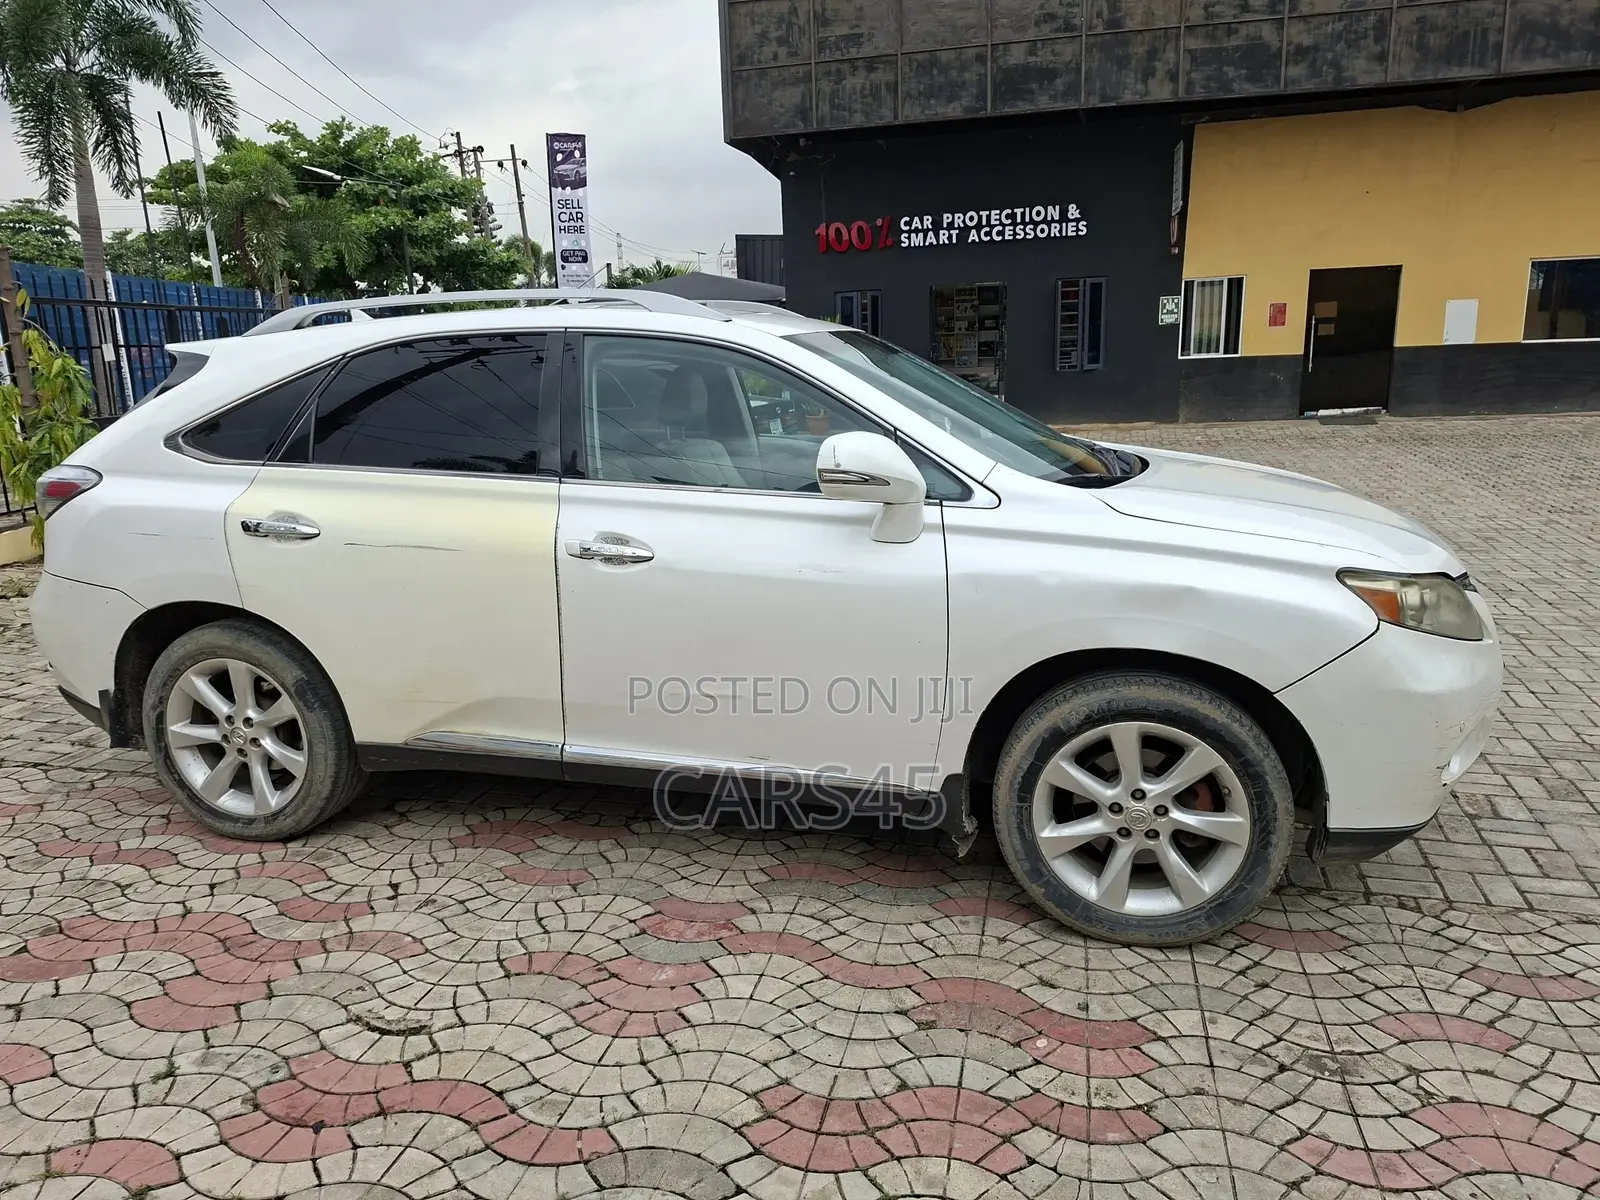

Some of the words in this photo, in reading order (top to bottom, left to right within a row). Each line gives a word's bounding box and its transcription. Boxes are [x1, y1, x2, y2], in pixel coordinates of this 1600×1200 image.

[557, 198, 583, 210] SELL
[557, 211, 584, 223] CAR
[900, 215, 933, 231] CAR
[942, 205, 1060, 229] PROTECTION
[1067, 203, 1082, 220] &
[558, 225, 585, 234] HERE
[815, 215, 894, 254] 100%
[900, 229, 959, 248] SMART
[967, 220, 1088, 244] ACCESSORIES
